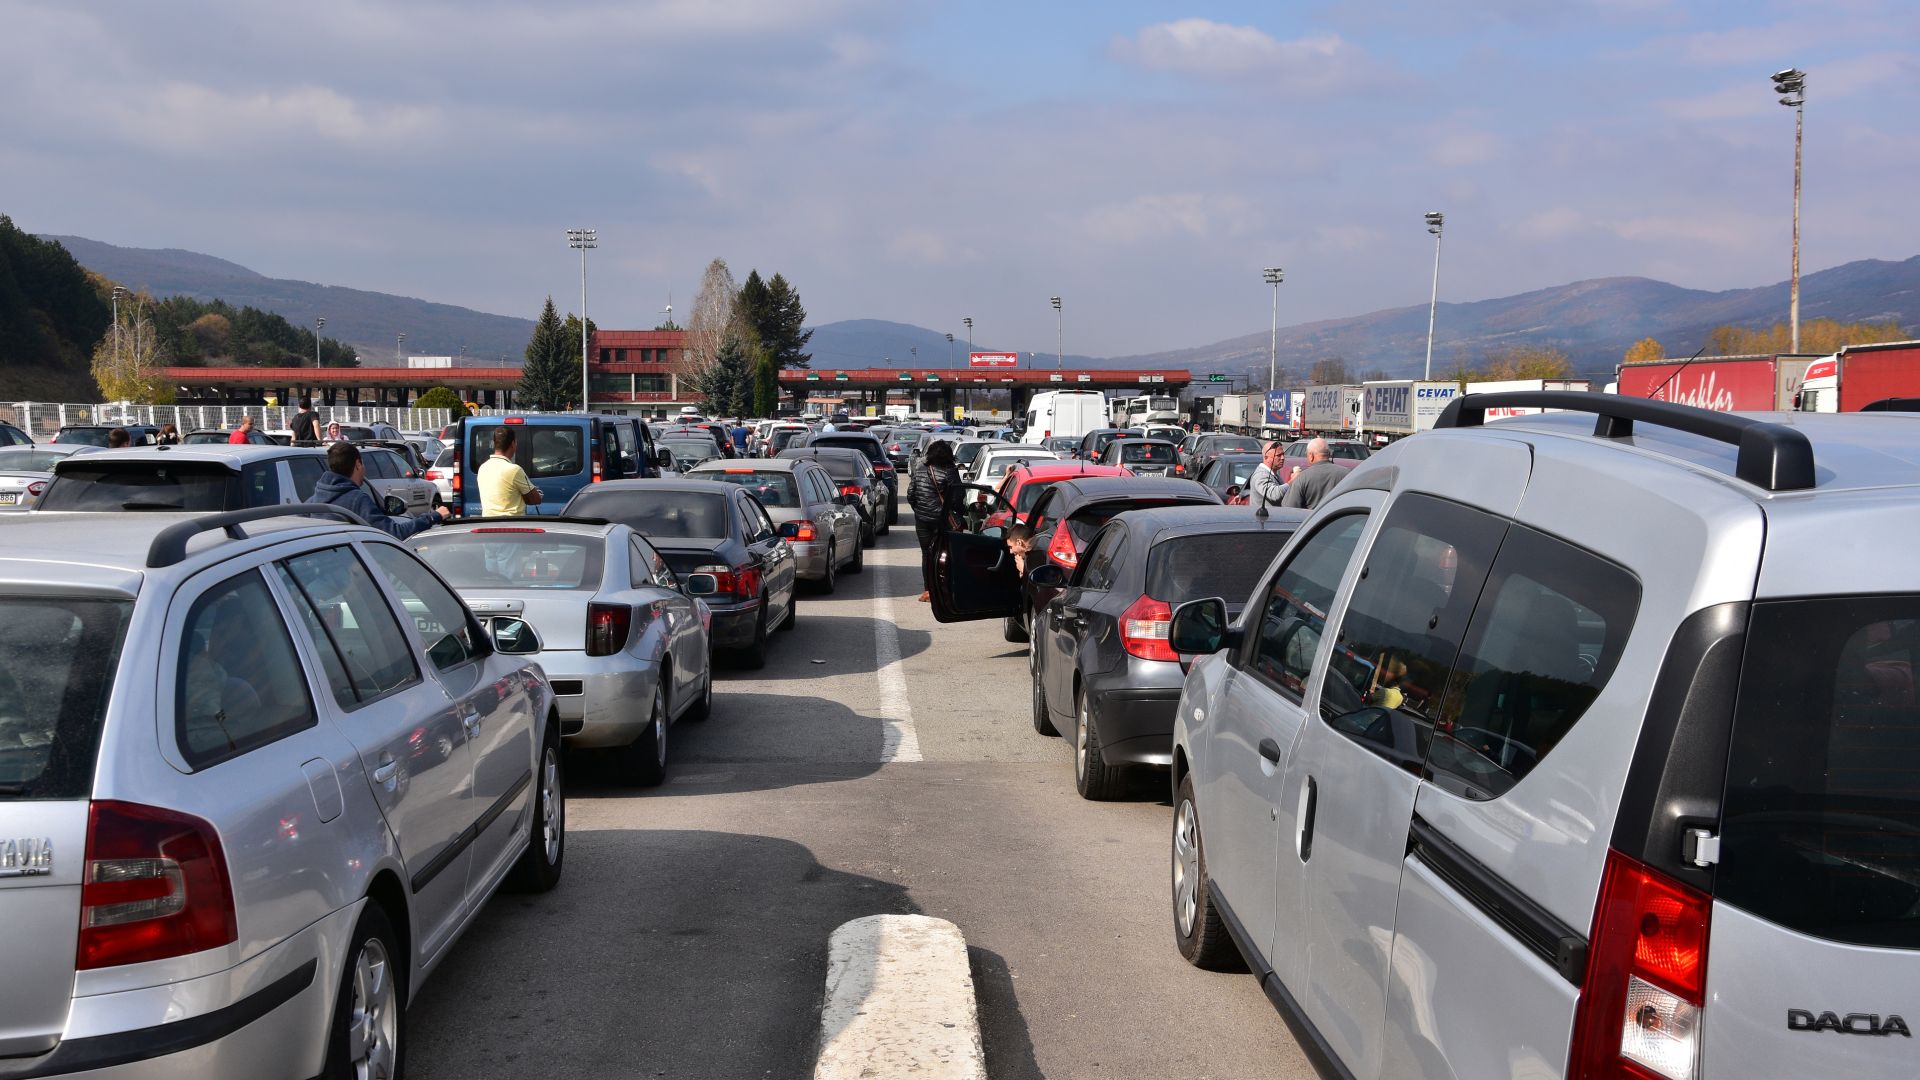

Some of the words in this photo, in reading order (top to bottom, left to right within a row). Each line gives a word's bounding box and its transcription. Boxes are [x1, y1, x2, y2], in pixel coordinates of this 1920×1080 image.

[1375, 387, 1409, 412] CEVAT
[1417, 388, 1456, 398] CEVAT
[1788, 1008, 1912, 1038] DACIA
